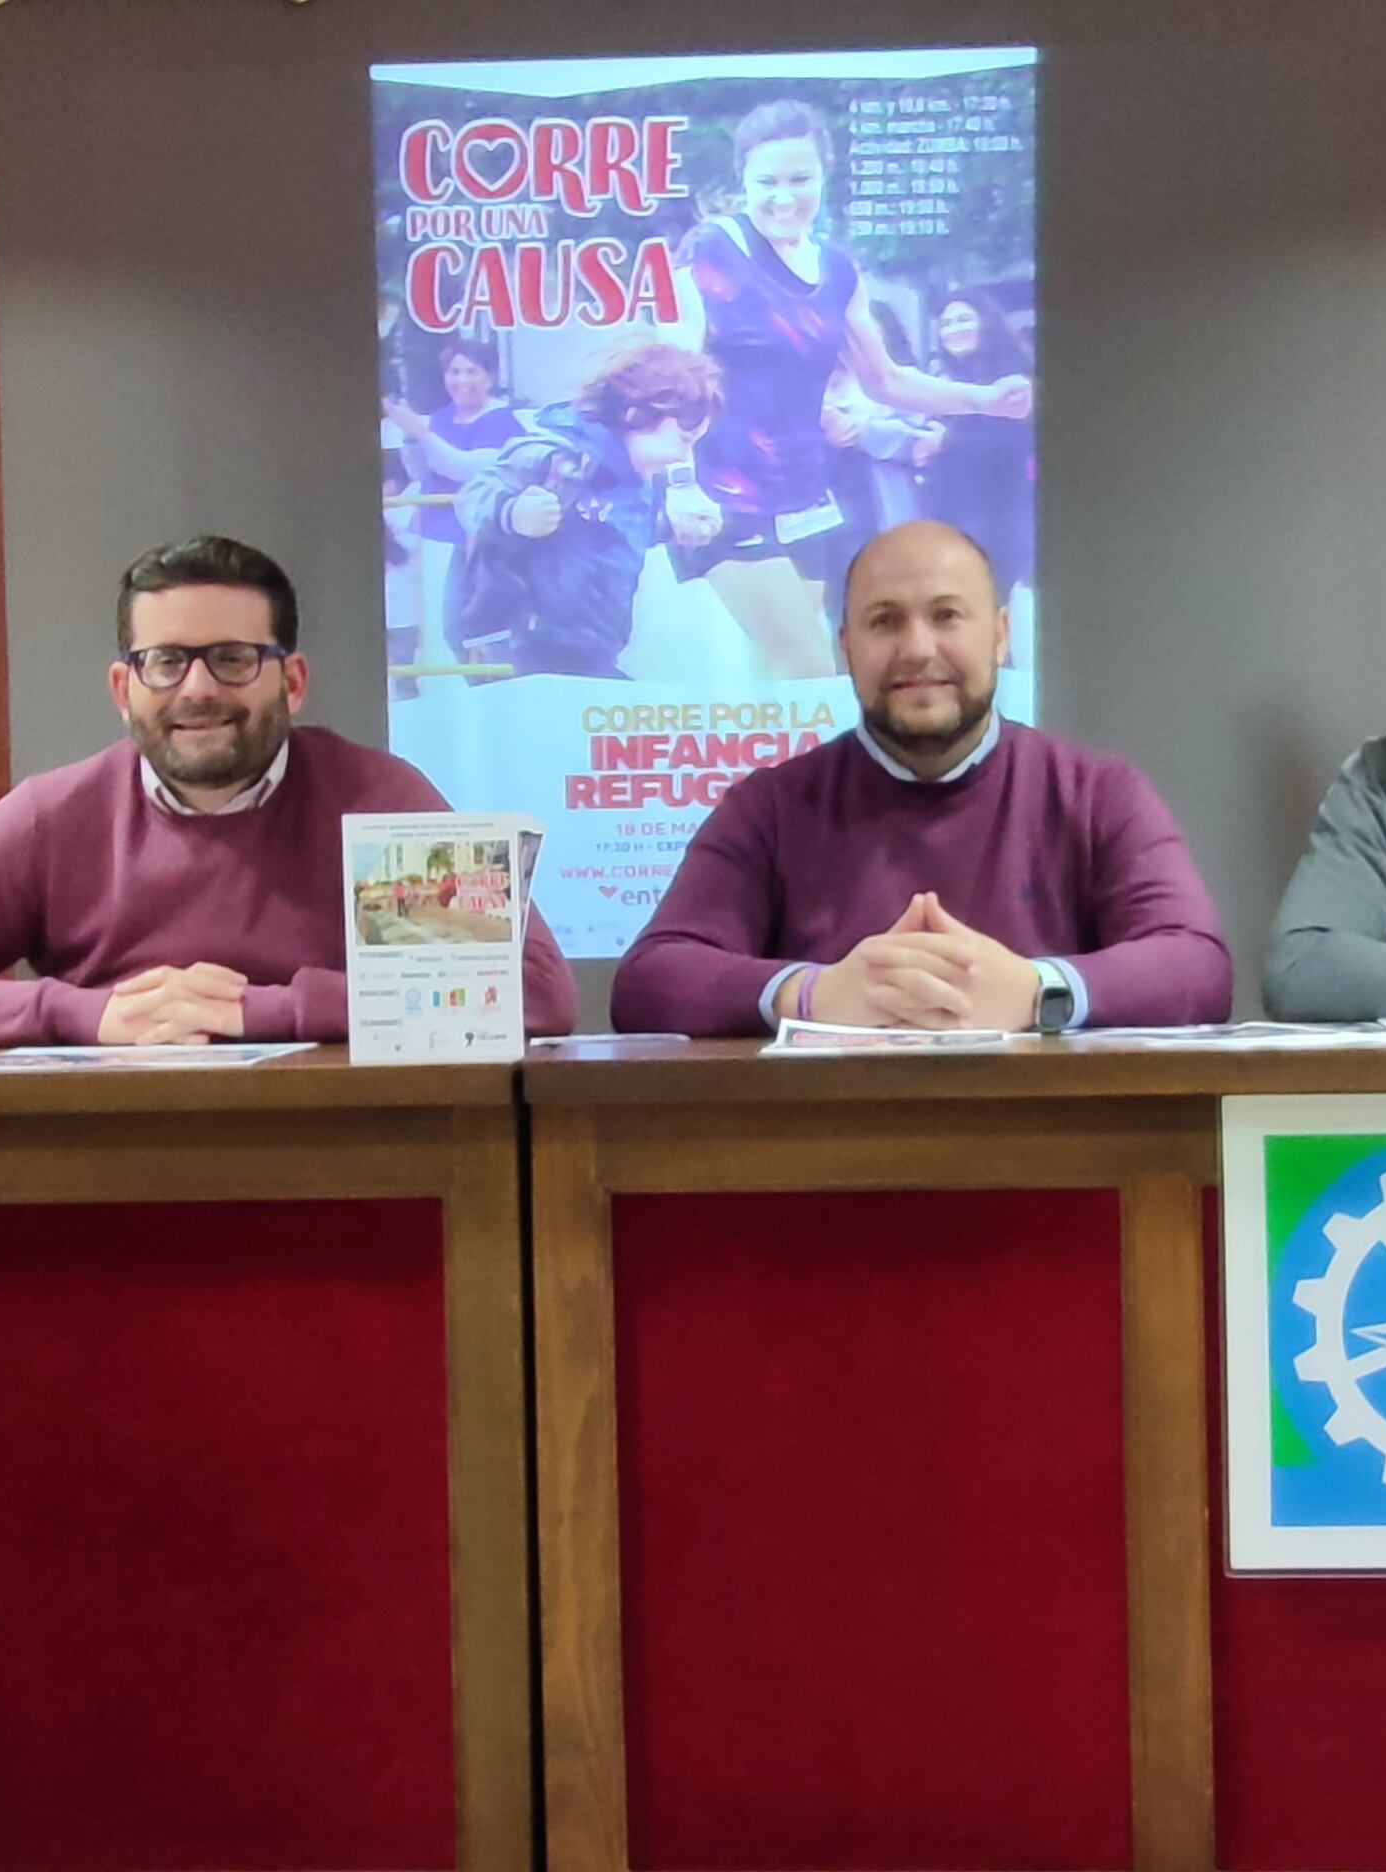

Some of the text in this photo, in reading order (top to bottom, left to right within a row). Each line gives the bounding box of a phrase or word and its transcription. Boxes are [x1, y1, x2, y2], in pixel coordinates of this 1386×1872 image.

[400, 116, 688, 217] CORRE
[407, 204, 548, 245] POR UNA
[406, 237, 679, 333] CAUSA
[581, 702, 835, 733] CORRE POR LA
[565, 772, 746, 810] REFUG
[617, 823, 635, 836] 18
[641, 822, 666, 836] DE
